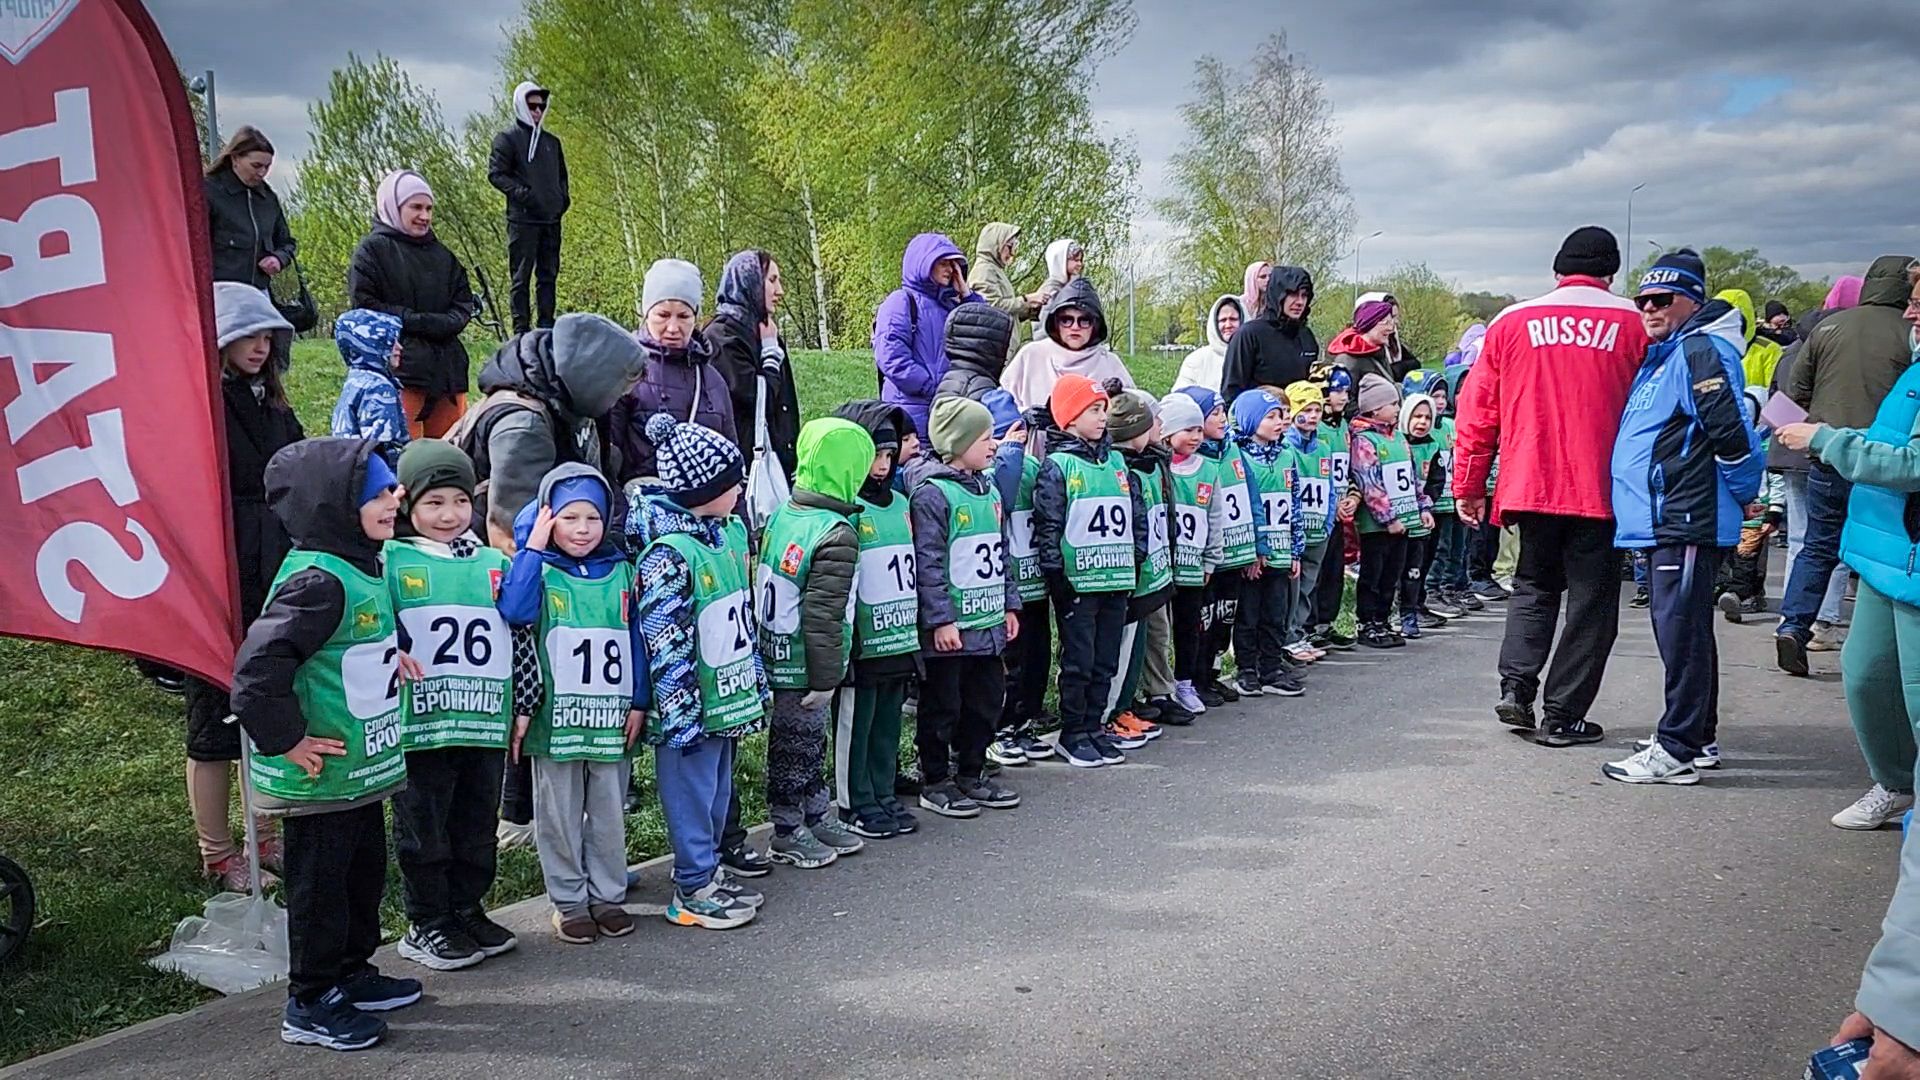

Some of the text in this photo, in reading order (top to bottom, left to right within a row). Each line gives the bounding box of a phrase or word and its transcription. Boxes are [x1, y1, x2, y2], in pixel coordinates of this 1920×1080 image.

[1527, 316, 1620, 352] RUSSIA
[677, 441, 709, 463] FILA
[682, 448, 716, 471] FILA
[686, 455, 722, 480] FILA
[691, 463, 728, 489] FILA
[1088, 504, 1126, 537] 49
[1263, 499, 1289, 526] 12
[888, 554, 915, 592] 13
[975, 543, 1005, 579] 33
[430, 616, 492, 666] 26
[573, 639, 622, 685] 18
[412, 690, 504, 715] БРОННИЦЫ
